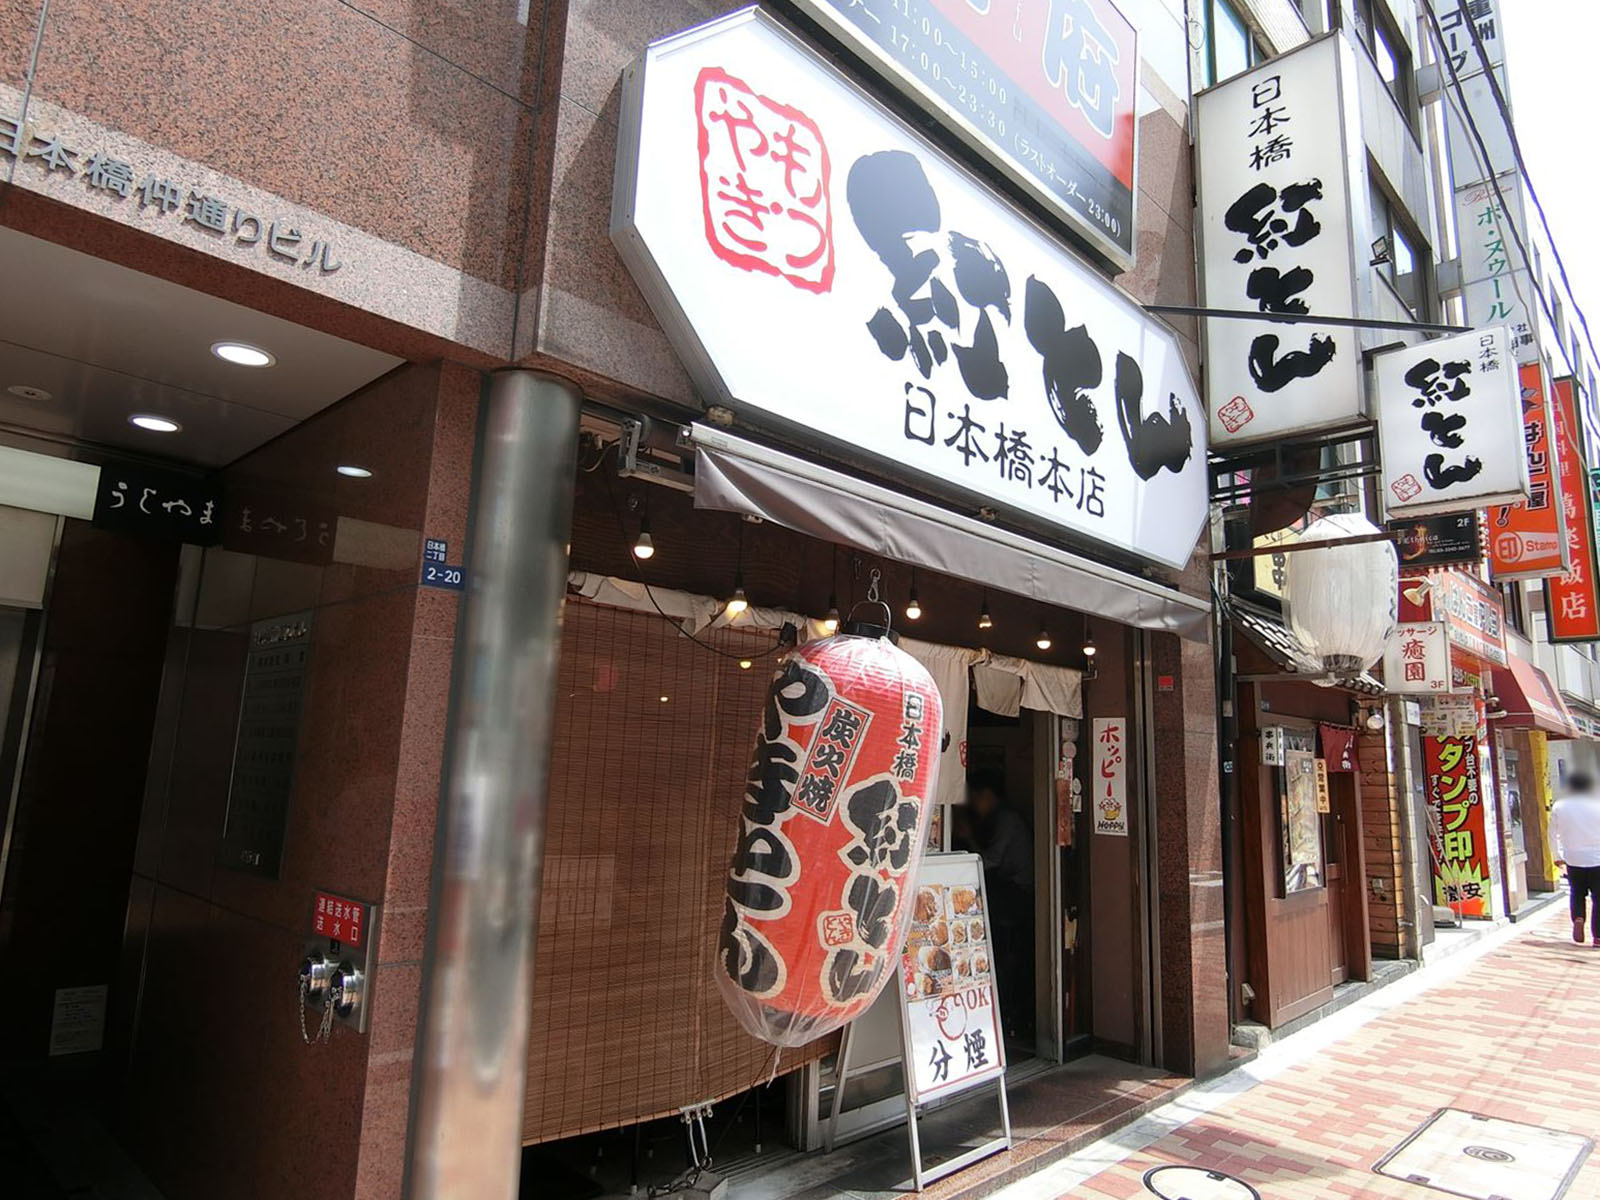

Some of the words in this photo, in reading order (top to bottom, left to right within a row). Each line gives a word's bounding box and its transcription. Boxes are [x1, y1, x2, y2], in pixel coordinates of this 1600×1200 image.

[1247, 75, 1293, 171] 日本橋
[0, 114, 343, 273] 日本橋仲通りビル
[845, 148, 1194, 483] 紅とん
[1224, 178, 1337, 393] 紅とん
[1478, 334, 1500, 374] 日本橋
[903, 380, 1107, 519] 日本橋本店
[1404, 357, 1483, 490] 紅とん
[1456, 518, 1470, 528] 2F
[427, 567, 461, 584] 2-20
[1430, 680, 1445, 689] 3F
[798, 707, 862, 813] 炭火焼
[892, 695, 926, 782] 日本橋
[1100, 722, 1122, 797] ホッピー
[1437, 735, 1473, 861] タンプ印
[966, 986, 989, 1010] OK
[929, 1028, 989, 1083] 分煙
